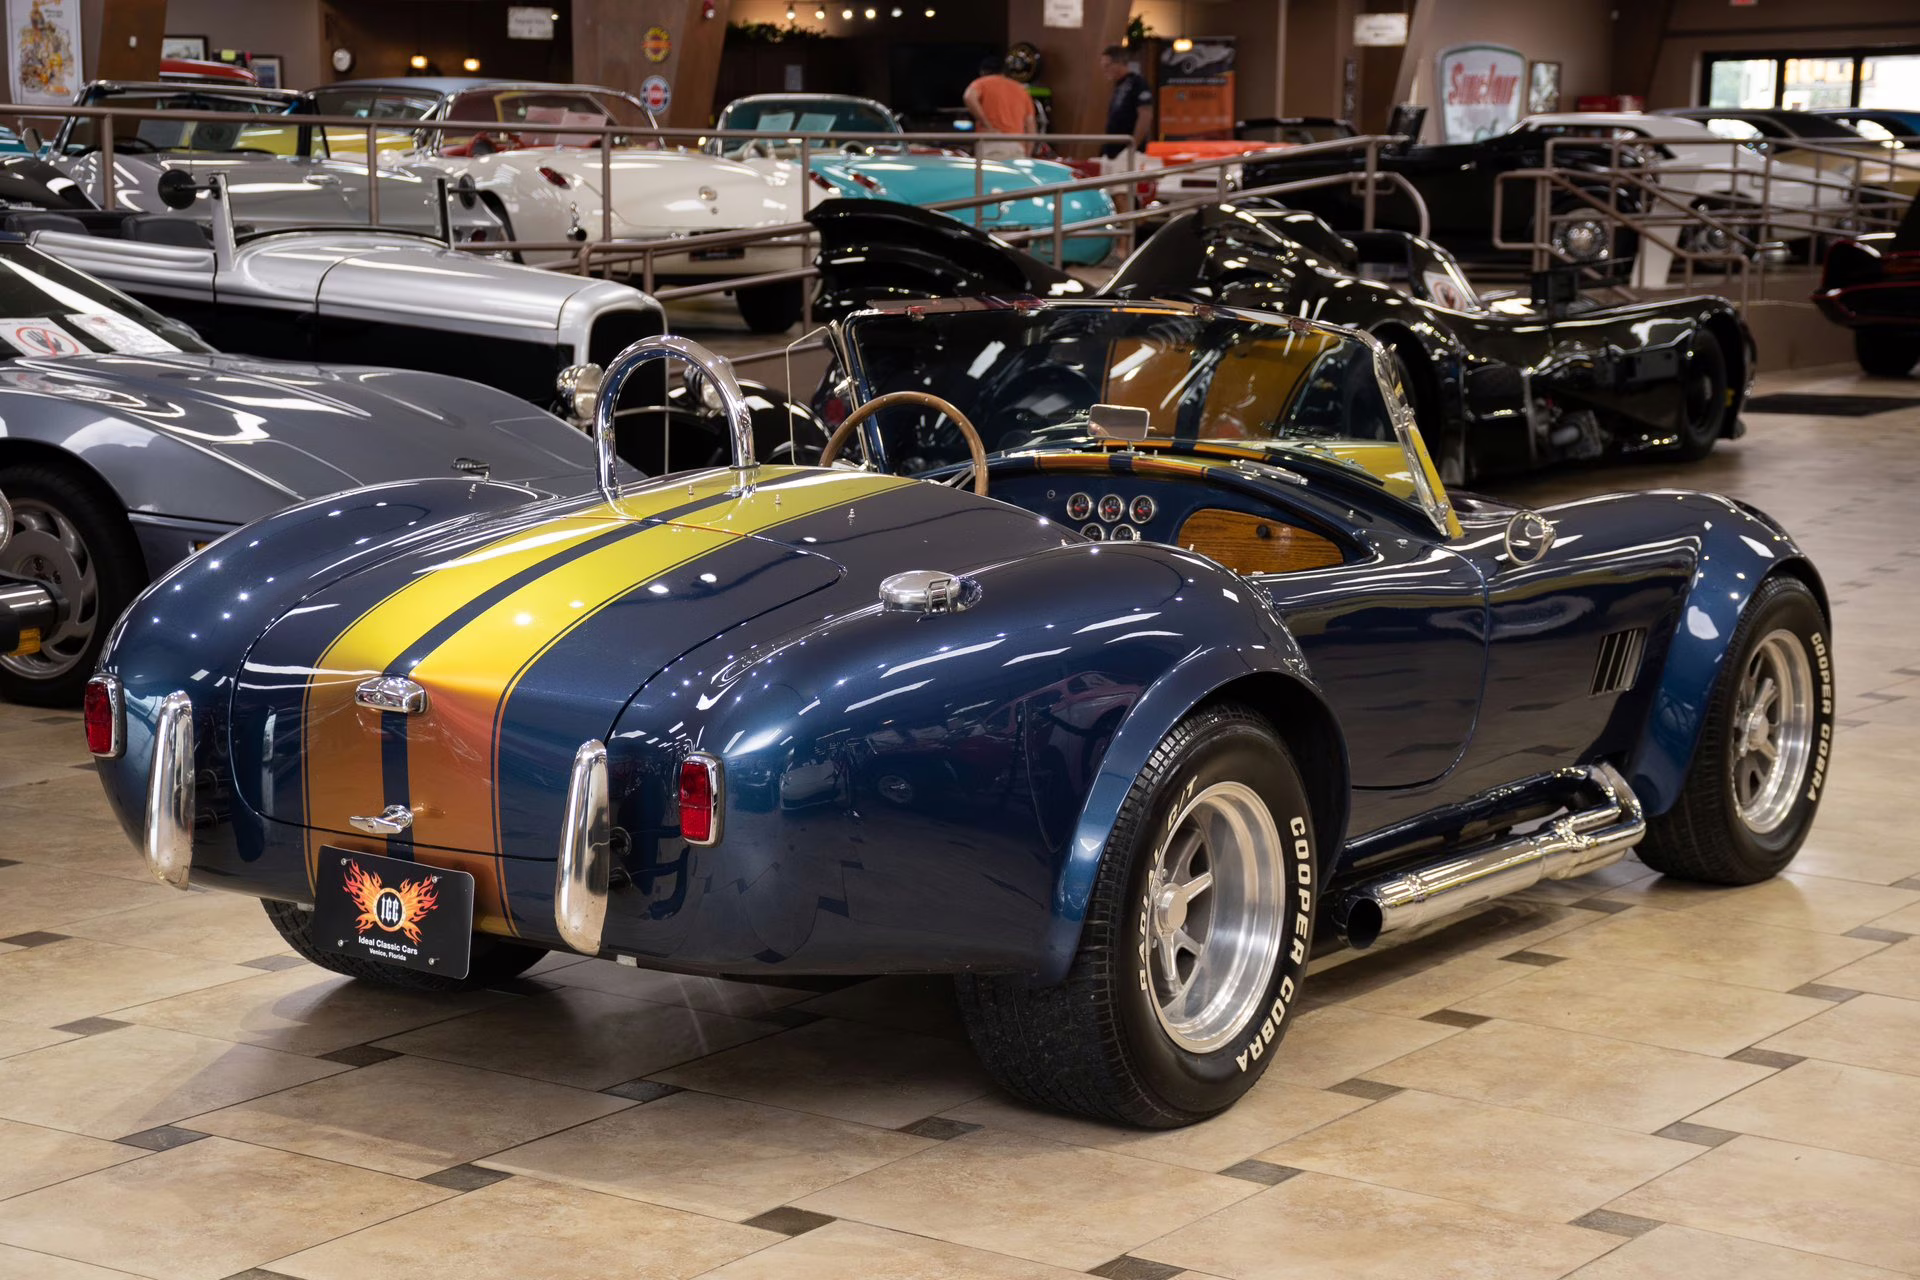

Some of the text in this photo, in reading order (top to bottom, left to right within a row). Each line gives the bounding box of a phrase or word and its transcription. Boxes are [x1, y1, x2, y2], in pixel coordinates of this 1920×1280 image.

[1807, 631, 1832, 801] COOPER COBRA
[381, 895, 399, 924] ICC
[358, 935, 418, 955] Ideal Classic Cars
[369, 947, 407, 961] Venice, Florida
[1235, 816, 1312, 1073] COOPER COBRA
